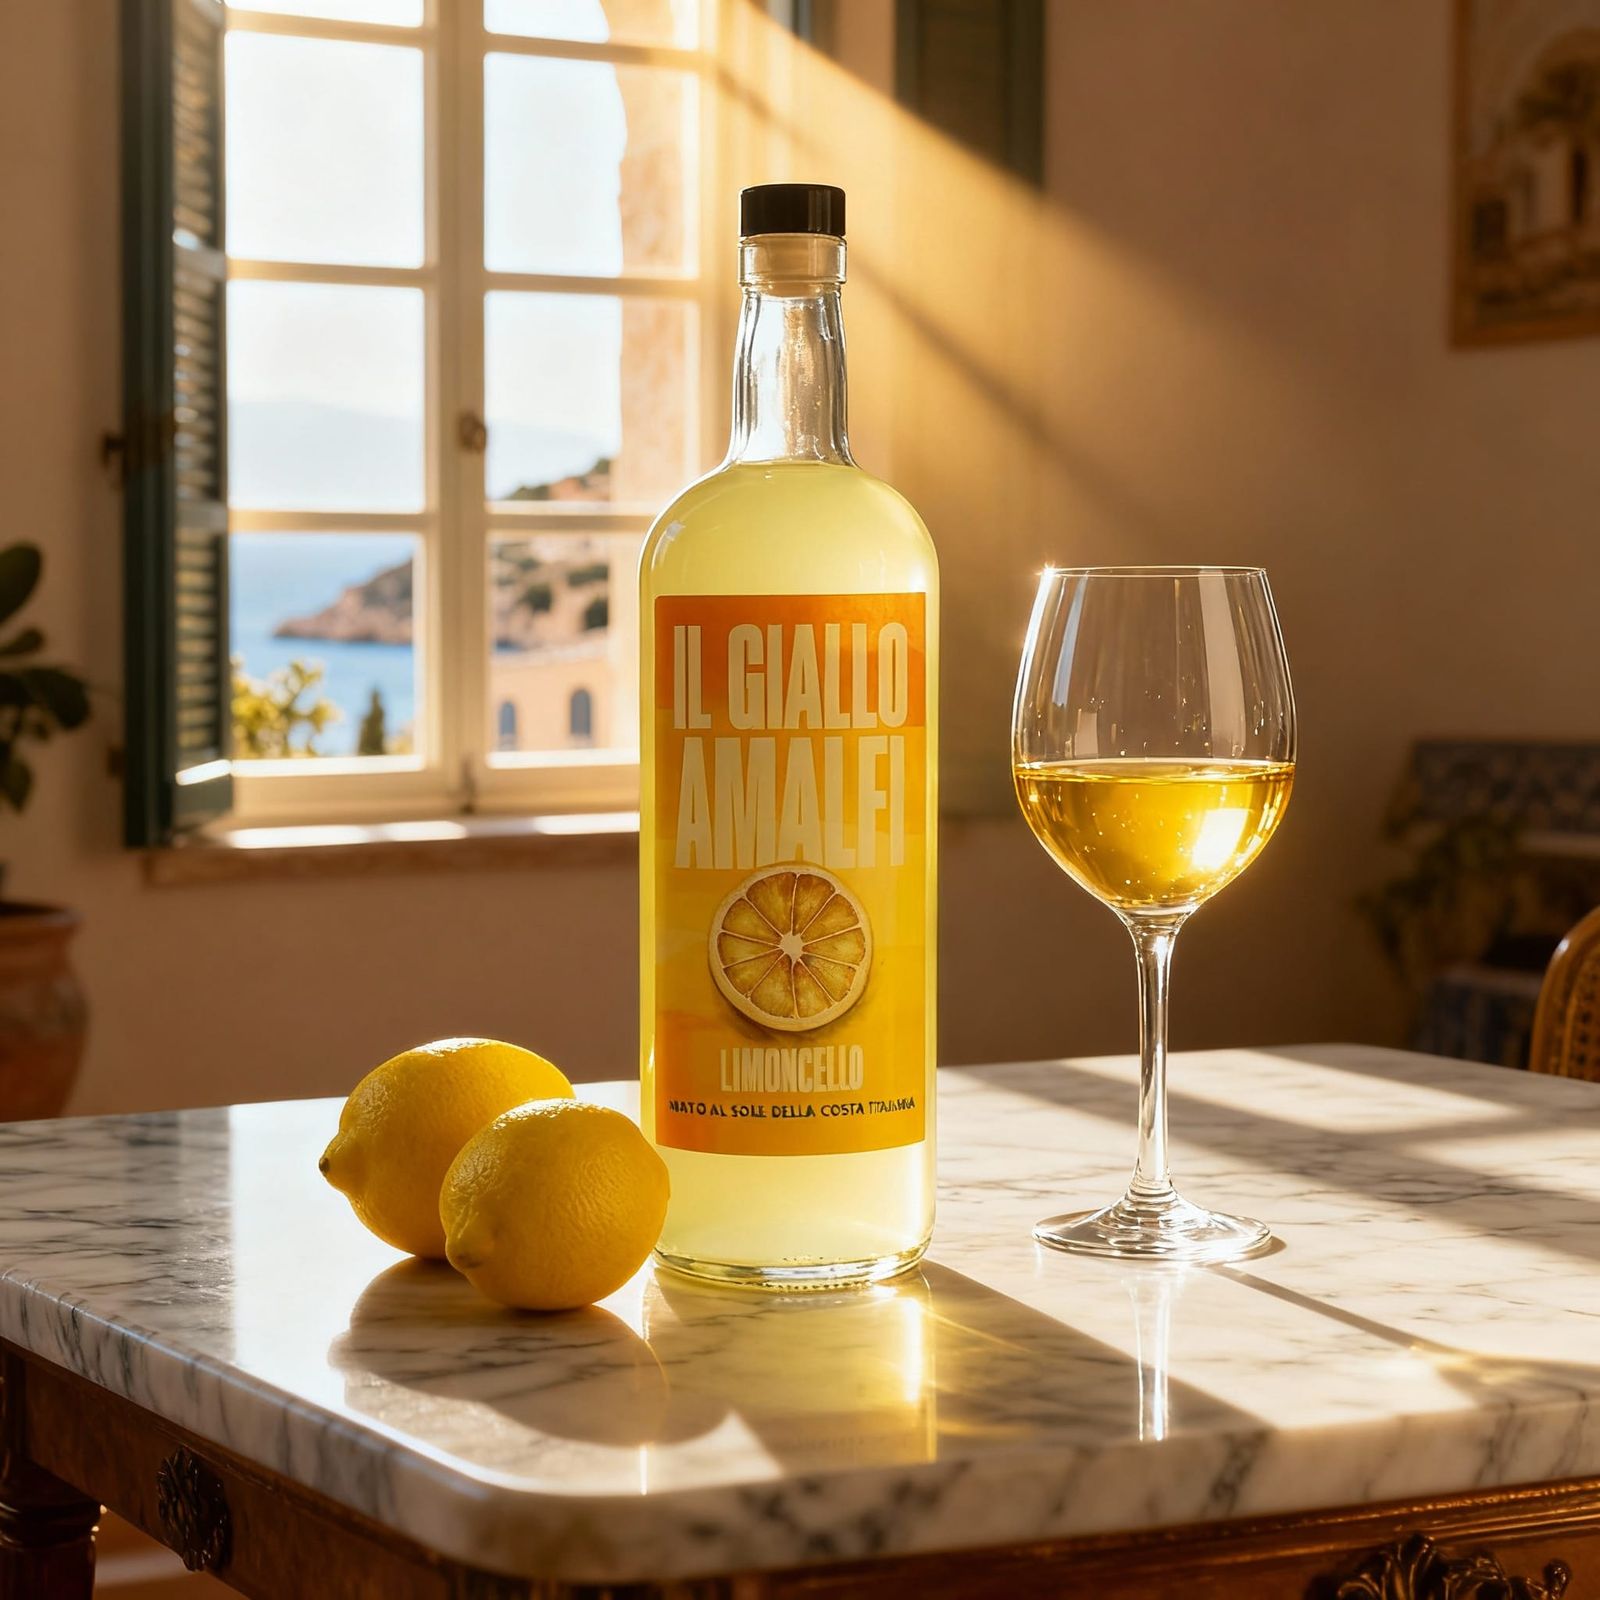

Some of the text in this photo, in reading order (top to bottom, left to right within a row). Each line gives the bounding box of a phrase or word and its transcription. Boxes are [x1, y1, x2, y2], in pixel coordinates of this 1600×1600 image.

[673, 622, 908, 730] IL GIALLO
[674, 735, 905, 870] AMALFI
[720, 1044, 864, 1093] LIMONCELLO
[710, 1103, 727, 1117] AL
[731, 1104, 767, 1118] SOLE
[772, 1104, 816, 1118] DELLA
[821, 1103, 864, 1116] COSTA
